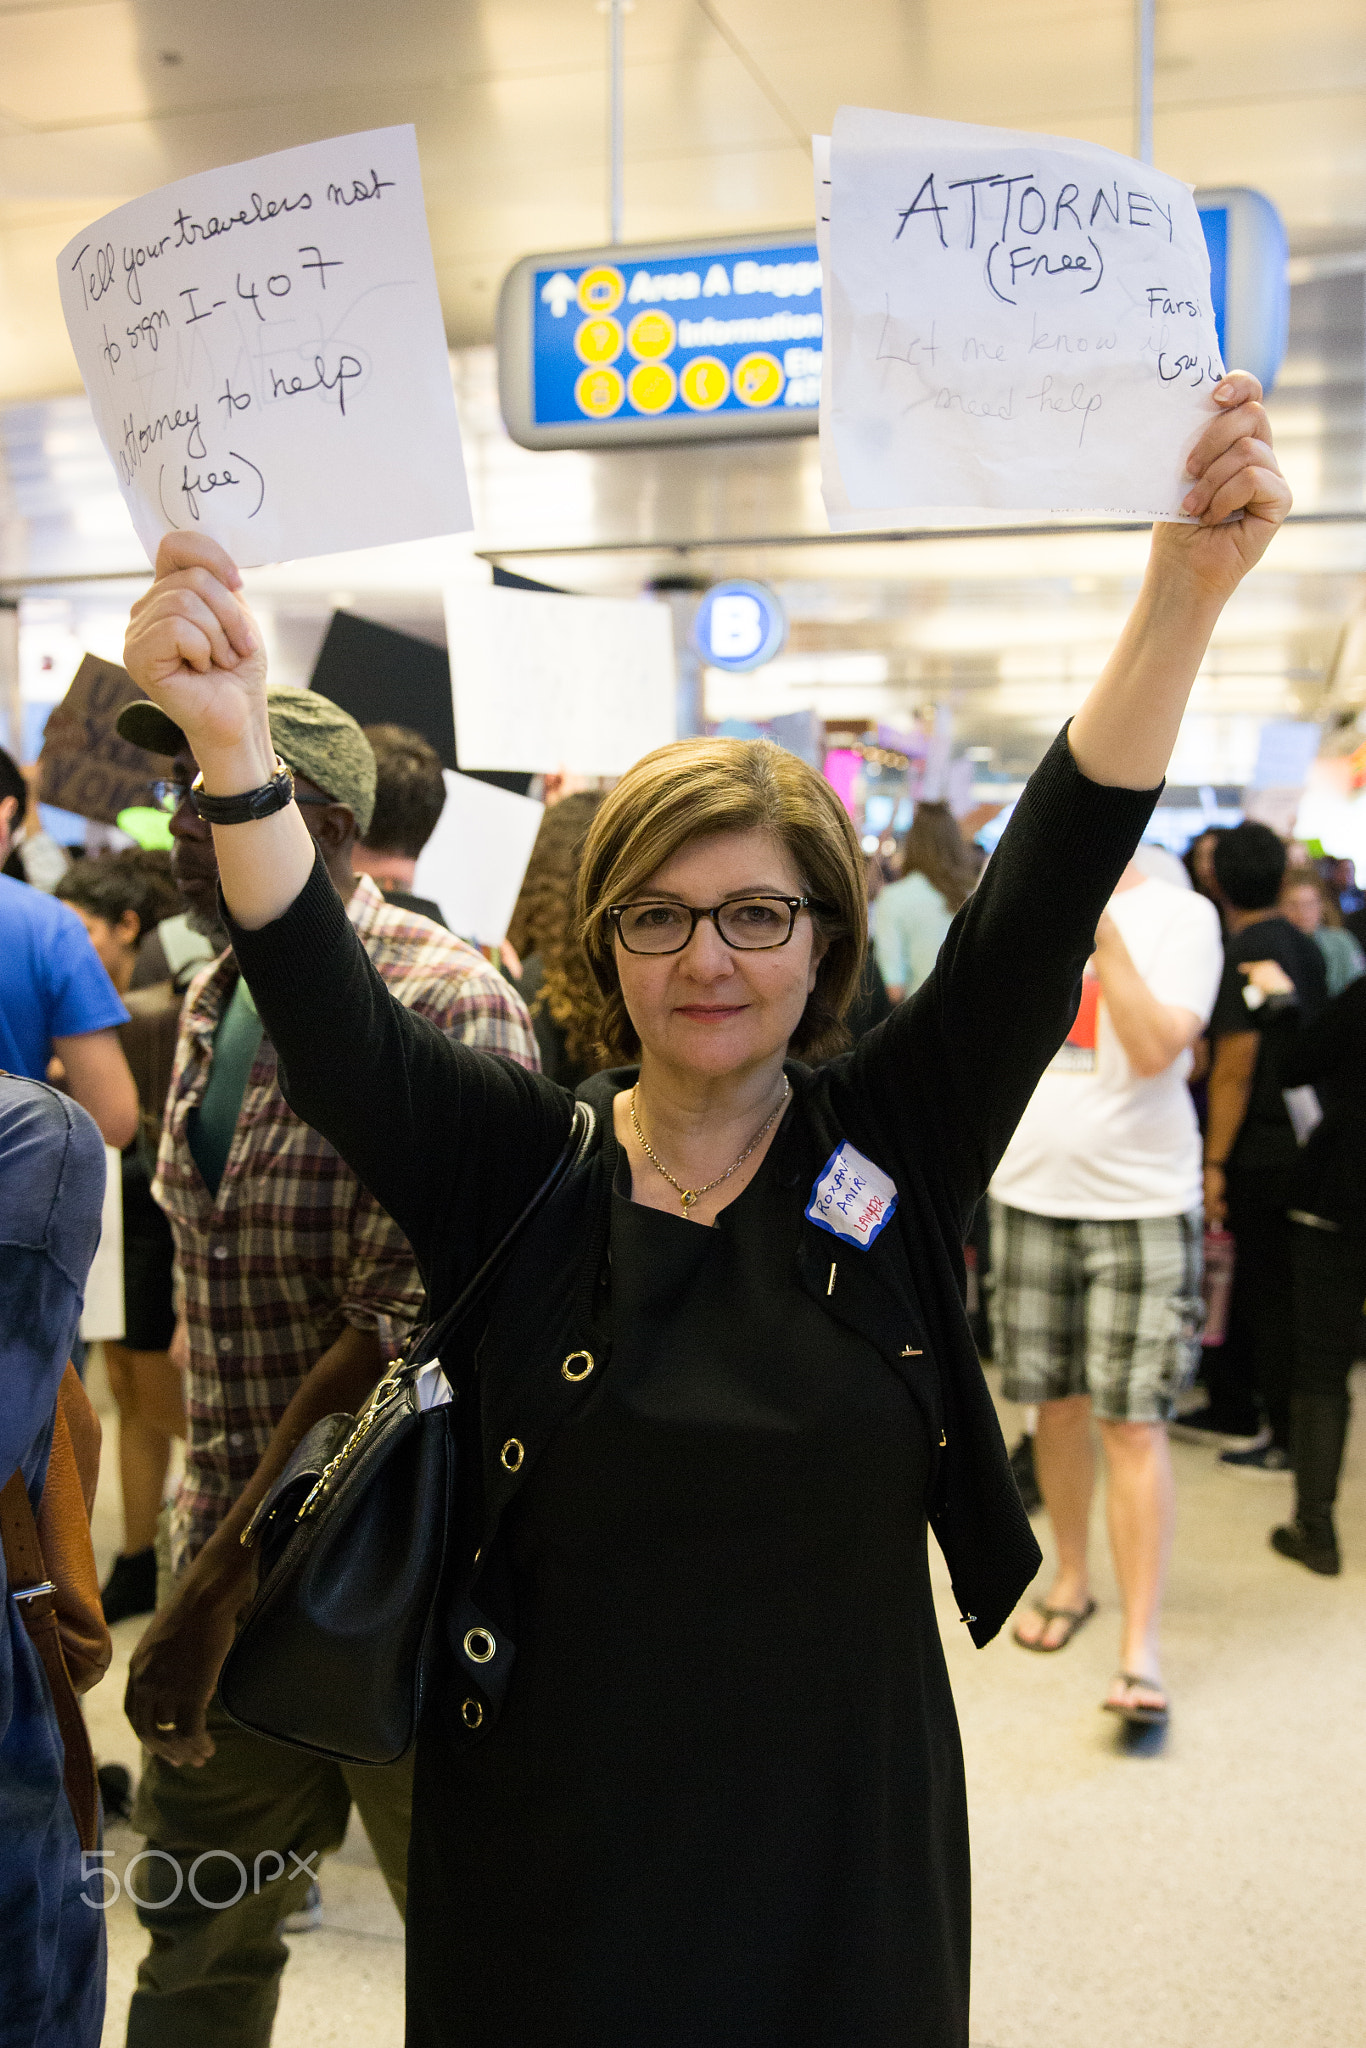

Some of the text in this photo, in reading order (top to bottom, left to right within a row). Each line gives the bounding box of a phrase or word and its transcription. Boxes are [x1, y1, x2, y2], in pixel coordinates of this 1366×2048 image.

[72, 168, 397, 311] Tell your travelers not
[894, 172, 1175, 249] ATTORNEY
[628, 260, 822, 305] Area A Bagg
[982, 235, 1105, 306] (Free)
[1145, 287, 1202, 319] Farsi
[103, 324, 121, 375] to
[126, 308, 170, 352] sign
[875, 292, 940, 367] Let
[961, 331, 1007, 363] me
[1027, 311, 1118, 354] know
[218, 377, 252, 419] to
[270, 354, 362, 417] help
[1025, 374, 1103, 449] help
[158, 450, 266, 530] (free)
[710, 595, 762, 658] B
[853, 1195, 885, 1233] LAWYER
